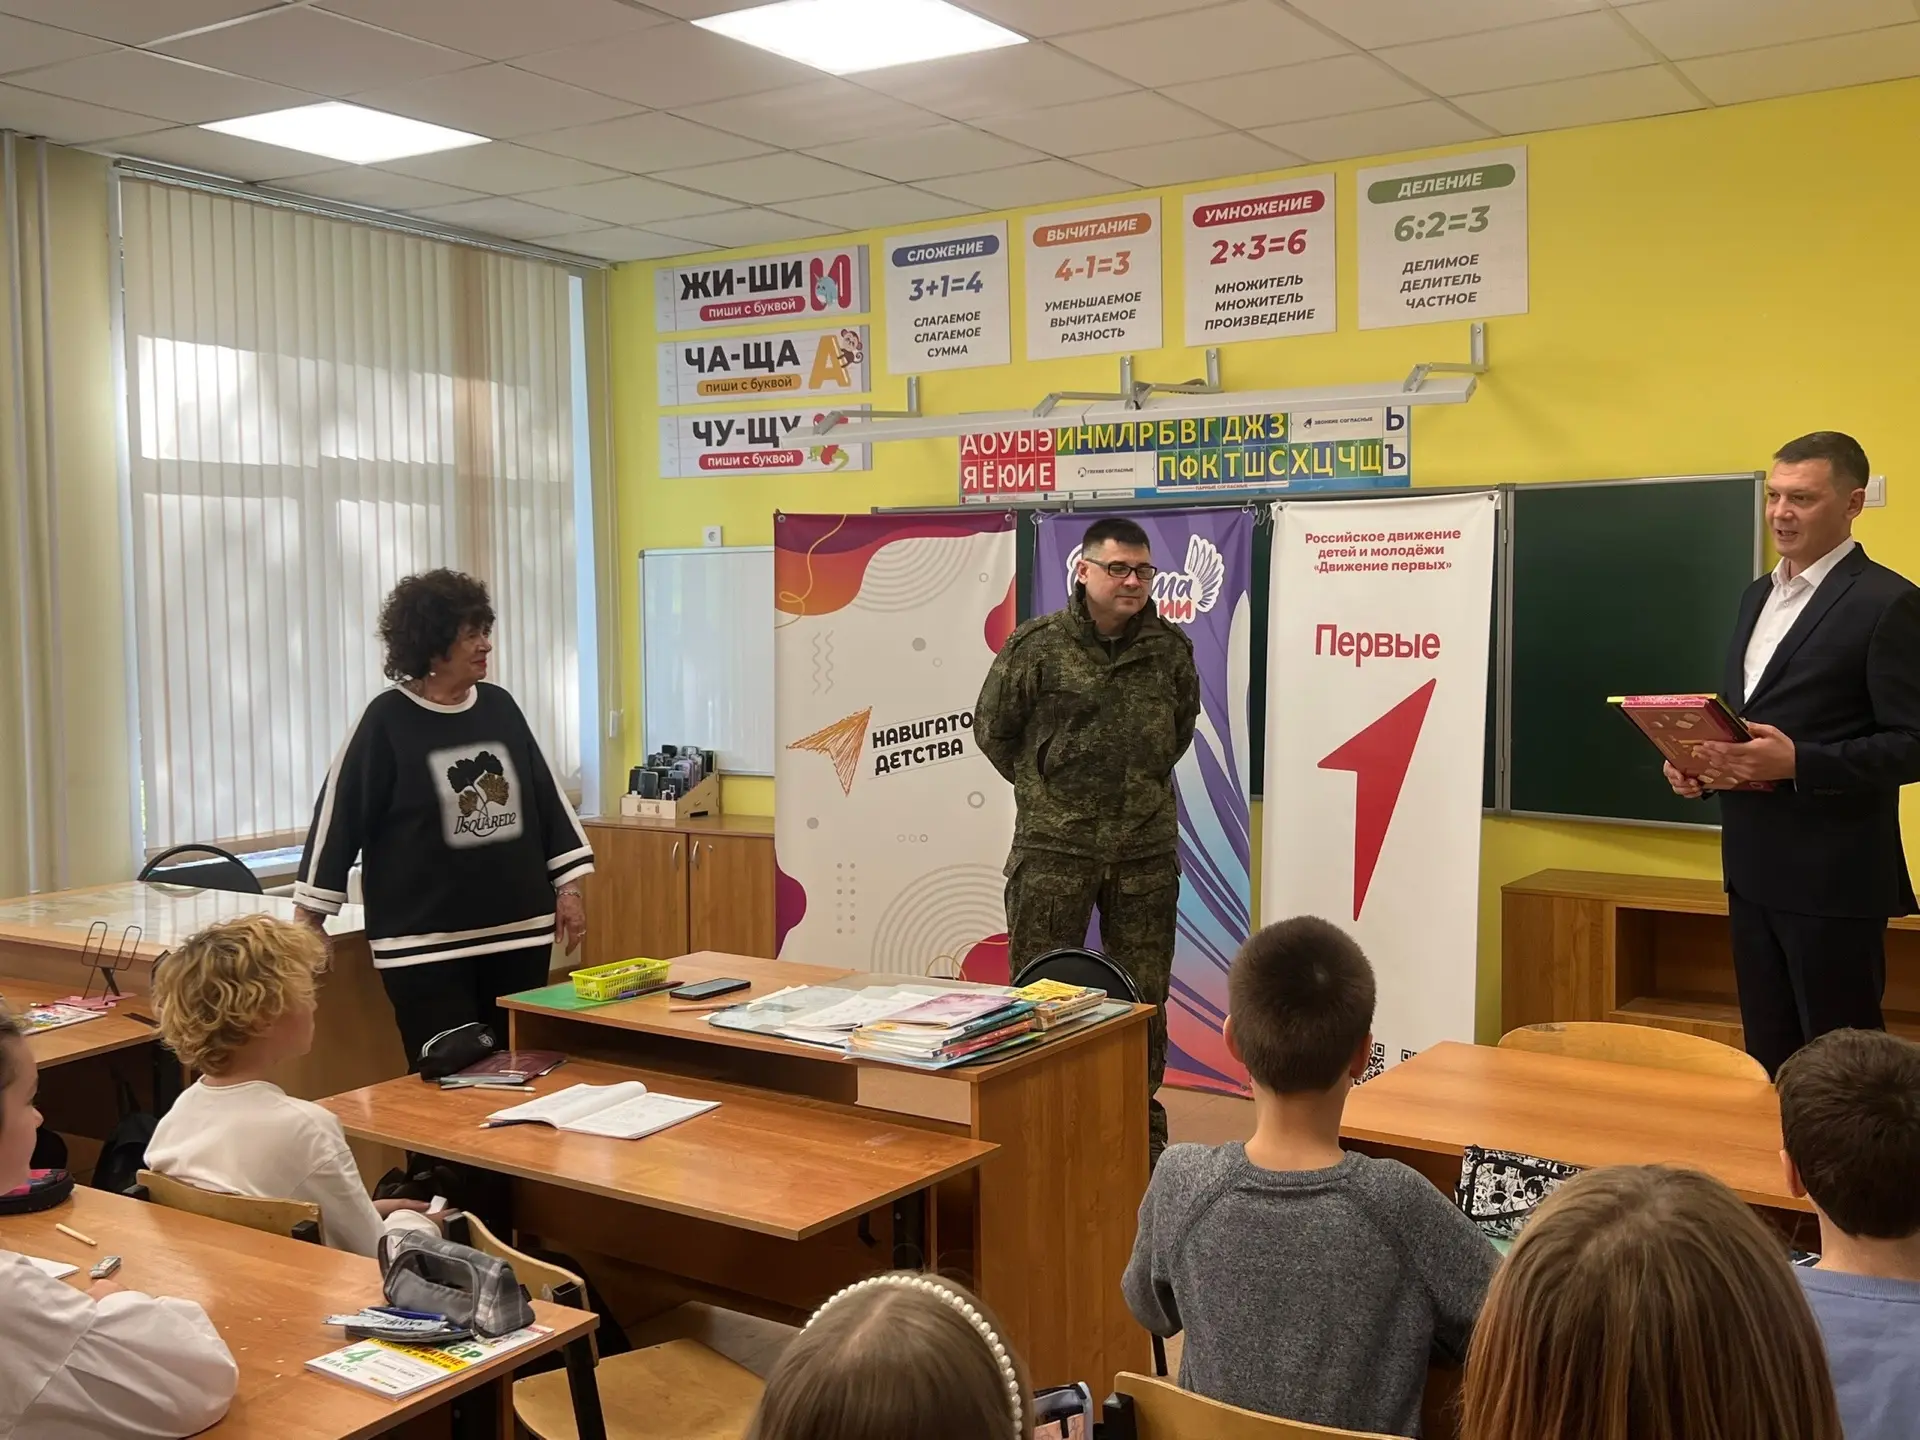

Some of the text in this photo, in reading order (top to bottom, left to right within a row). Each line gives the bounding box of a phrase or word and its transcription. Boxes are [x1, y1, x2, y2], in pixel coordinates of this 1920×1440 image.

[1397, 172, 1483, 199] ДЕЛЕНИЕ
[1204, 196, 1313, 223] УМНОЖЕНИЕ
[1046, 218, 1138, 242] ВЫЧИТАНИЕ
[1394, 204, 1491, 242] 6:2=3
[907, 241, 984, 263] СЛОЖЕНИЕ
[1054, 250, 1131, 282] 4-1=3
[1402, 254, 1480, 275] ДЕЛИМОЕ
[680, 260, 803, 301] ЖИ-ШИ
[908, 270, 984, 301] 3+1=4
[1214, 274, 1304, 295] МНОЖИТЕЛЬ
[1399, 272, 1482, 294] ДЕЛИТЕЛЬ
[708, 299, 796, 318] пиши с буквой
[1044, 291, 1142, 312] УМЕНЬШАЕМОЕ
[1214, 292, 1304, 312] МНОЖИТЕЛЬ
[1405, 291, 1478, 310] ЧАСТНОЕ
[914, 310, 981, 328] СЛАГАЕМОЕ
[1050, 308, 1137, 328] ВЫЧИТАЕМОЕ
[1204, 308, 1316, 331] ПРОИЗВЕДЕНИЕ
[914, 327, 981, 344] СЛАГАЕМОЕ
[1060, 327, 1126, 344] РАЗНОСТЬ
[685, 339, 801, 373] ЧА-ЩА
[927, 345, 968, 358] СУММА
[808, 335, 851, 390] А
[705, 375, 793, 393] пиши с буквой
[707, 451, 794, 466] пиши с буквой
[1305, 528, 1462, 544] Российское движение
[1318, 544, 1445, 560] детей и молодёжи
[1313, 560, 1452, 574] «Движение первых»
[1315, 624, 1441, 667] Первые
[872, 711, 975, 749] НАВИГАТО
[875, 738, 963, 775] ДЕТСТВА
